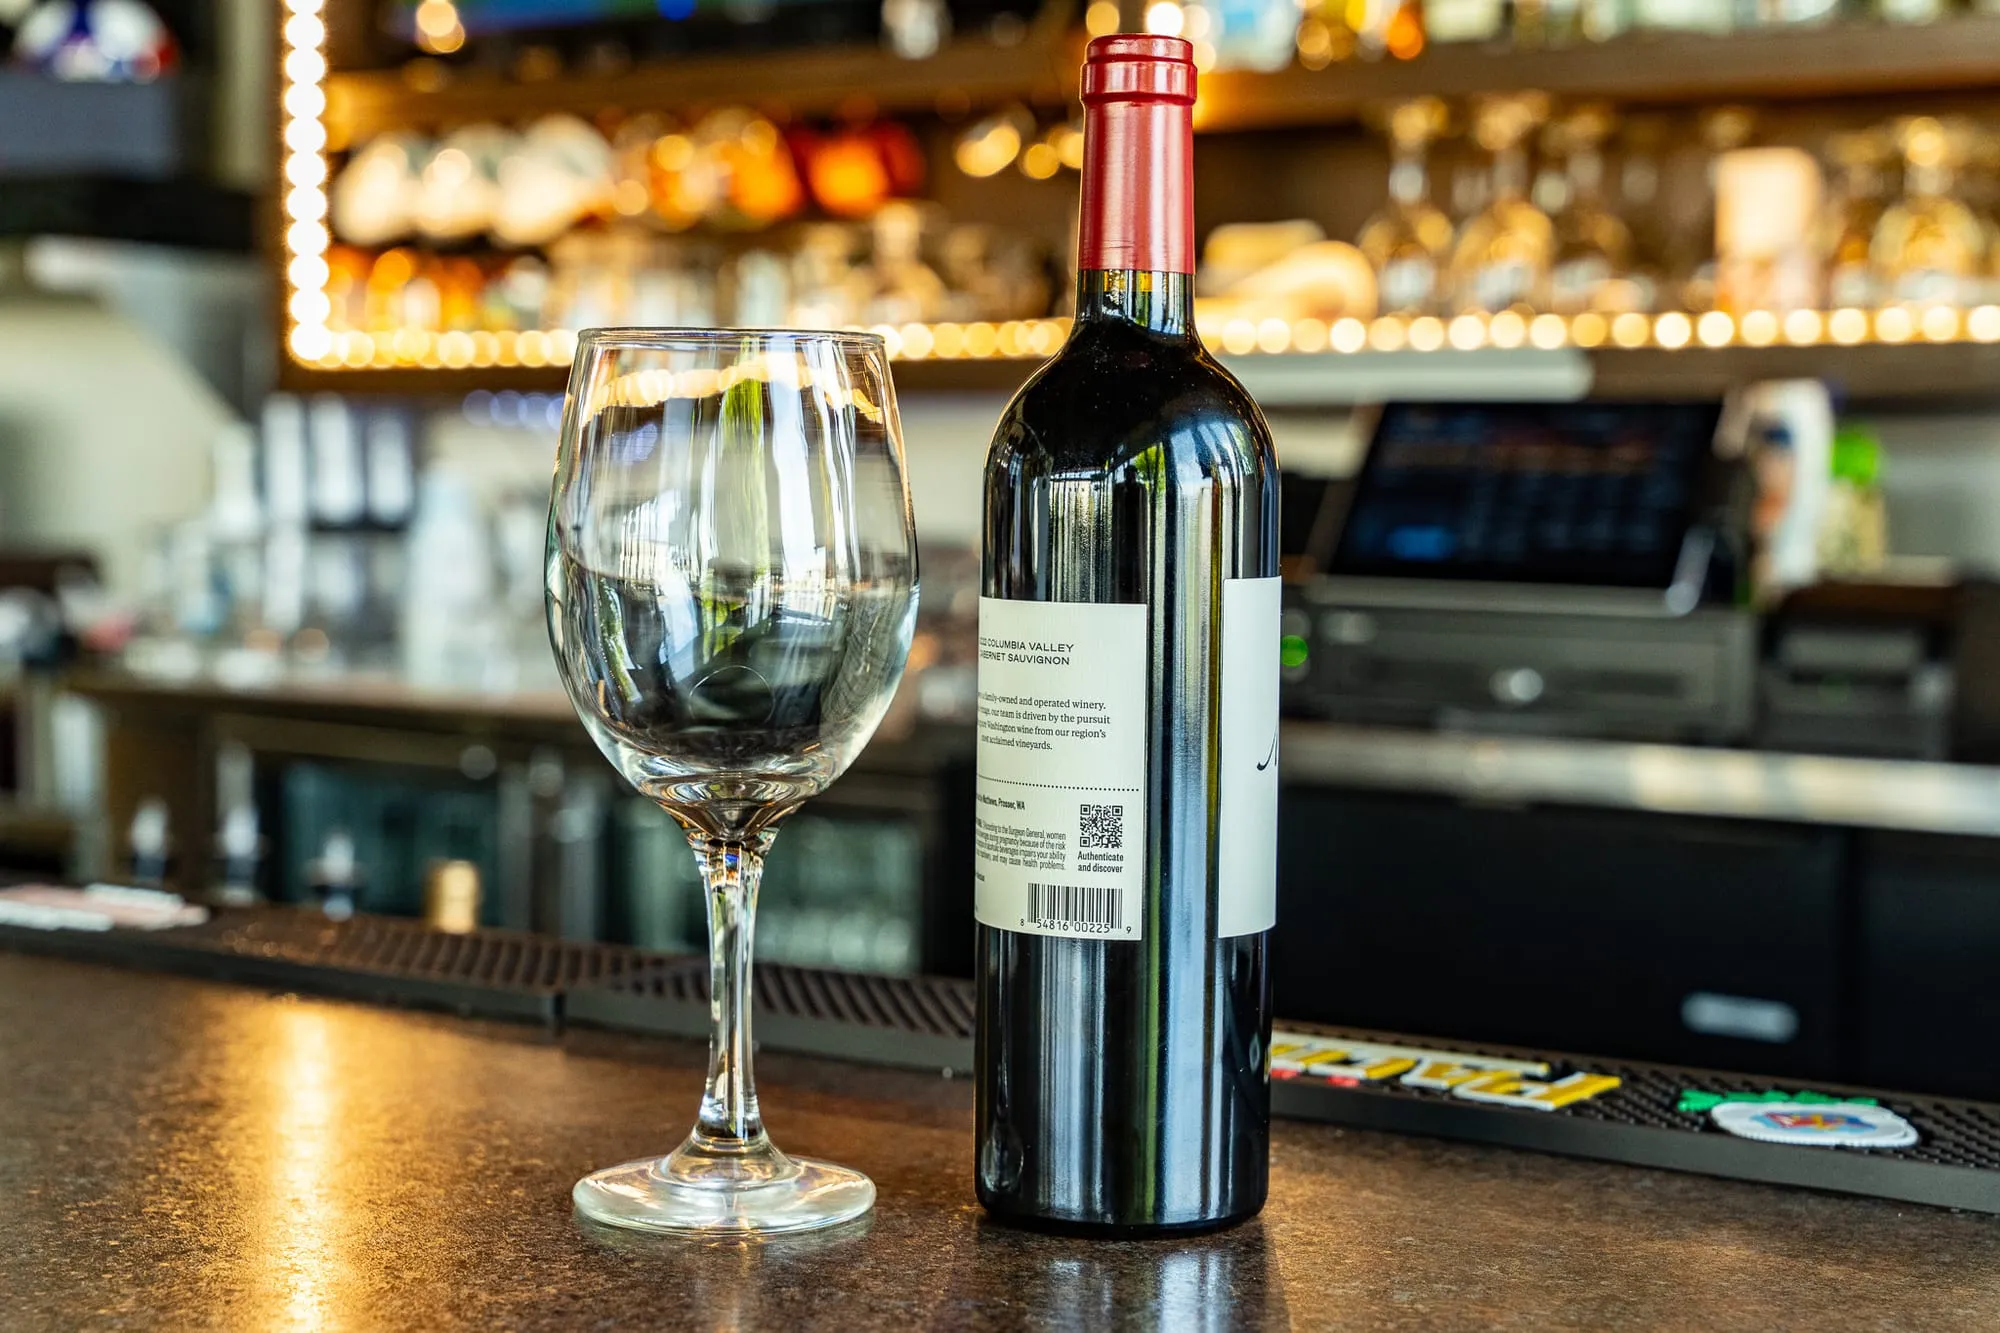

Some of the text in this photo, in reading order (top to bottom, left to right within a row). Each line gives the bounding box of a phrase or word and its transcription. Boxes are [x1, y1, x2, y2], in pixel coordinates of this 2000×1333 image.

[988, 639, 1025, 650] COLUMBIA
[1029, 642, 1074, 652] VALLEY
[1008, 655, 1070, 665] SAUVIGNON
[1019, 697, 1032, 705] and
[1034, 699, 1070, 710] operated
[1072, 701, 1106, 711] winery.
[1016, 711, 1021, 719] is
[1022, 711, 1047, 721] driven
[1049, 713, 1058, 723] by
[1060, 714, 1074, 722] the
[1077, 715, 1110, 725] pursuit
[1017, 726, 1033, 734] wine
[1035, 726, 1053, 735] from
[1071, 729, 1106, 739] region's
[1016, 739, 1052, 751] vineyards.
[1026, 828, 1045, 839] General,
[1046, 832, 1066, 840] women
[1020, 838, 1039, 848] because
[1040, 839, 1045, 849] of
[1046, 841, 1055, 849] the
[1056, 842, 1065, 850] risk
[1049, 852, 1065, 861] ability
[1078, 851, 1124, 862] Authenticate
[1040, 859, 1065, 870] problems.
[1078, 862, 1123, 873] and discover
[1037, 920, 1068, 931] 54816
[1074, 921, 1110, 933] 00225
[1126, 926, 1131, 934] 9
